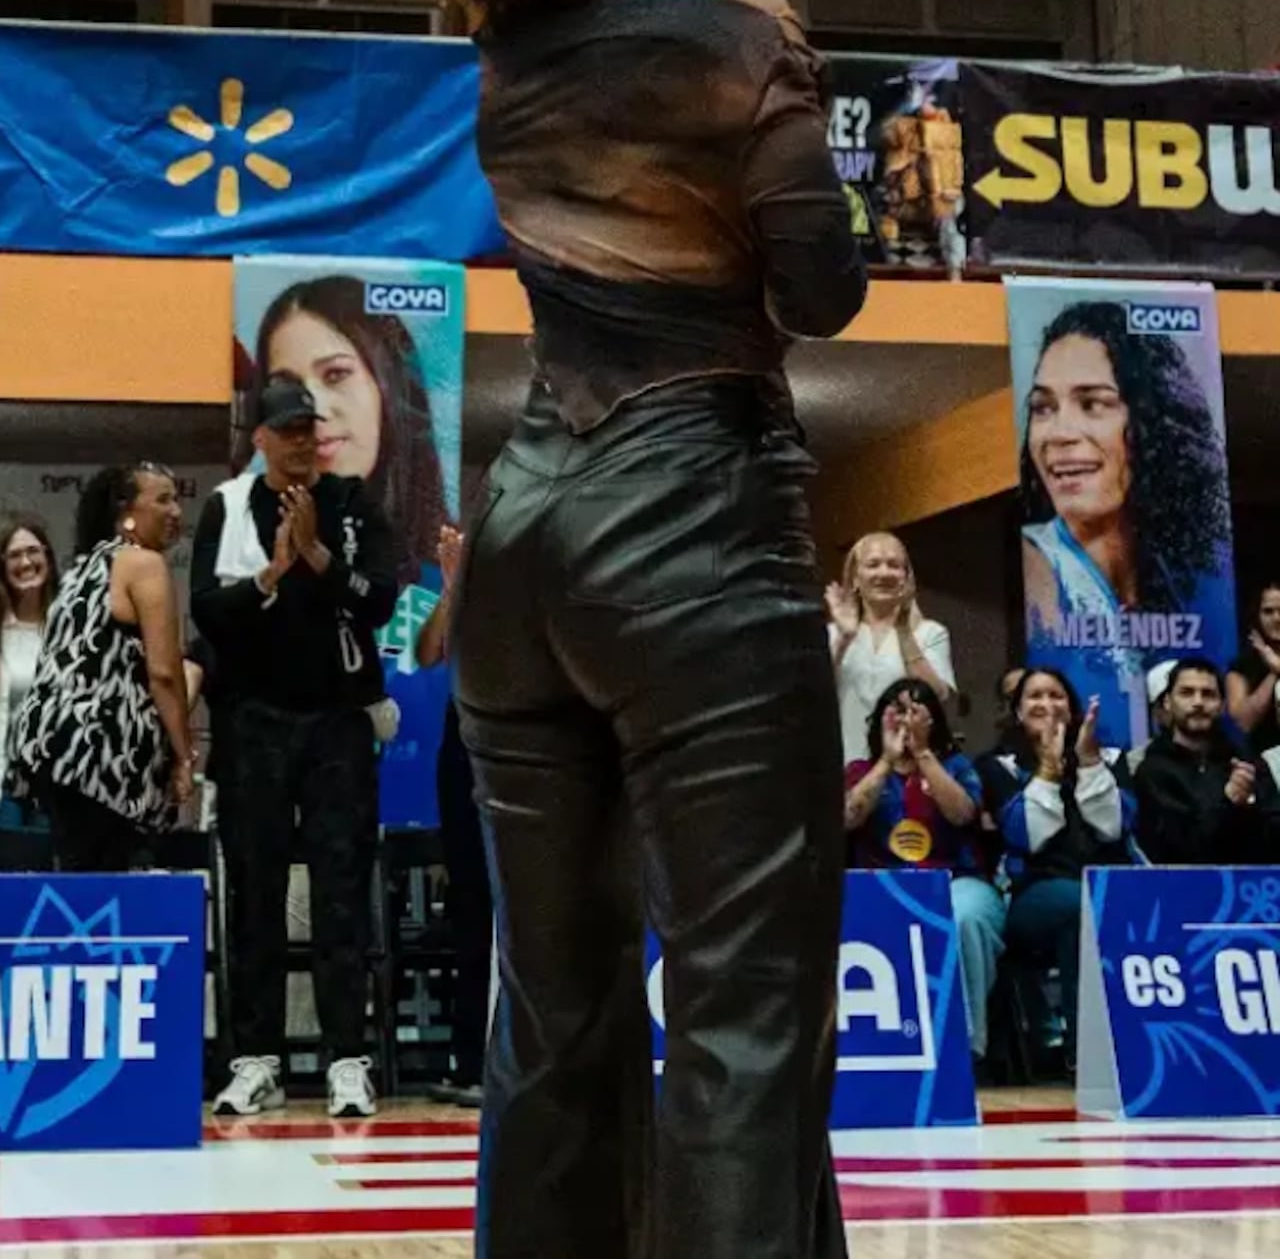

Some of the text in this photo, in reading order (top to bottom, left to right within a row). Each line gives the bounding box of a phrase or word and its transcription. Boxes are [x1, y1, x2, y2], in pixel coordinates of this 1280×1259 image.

[826, 95, 872, 148] E?
[371, 286, 444, 309] GOYA
[1131, 307, 1198, 330] GOYA
[1122, 954, 1186, 1008] es
